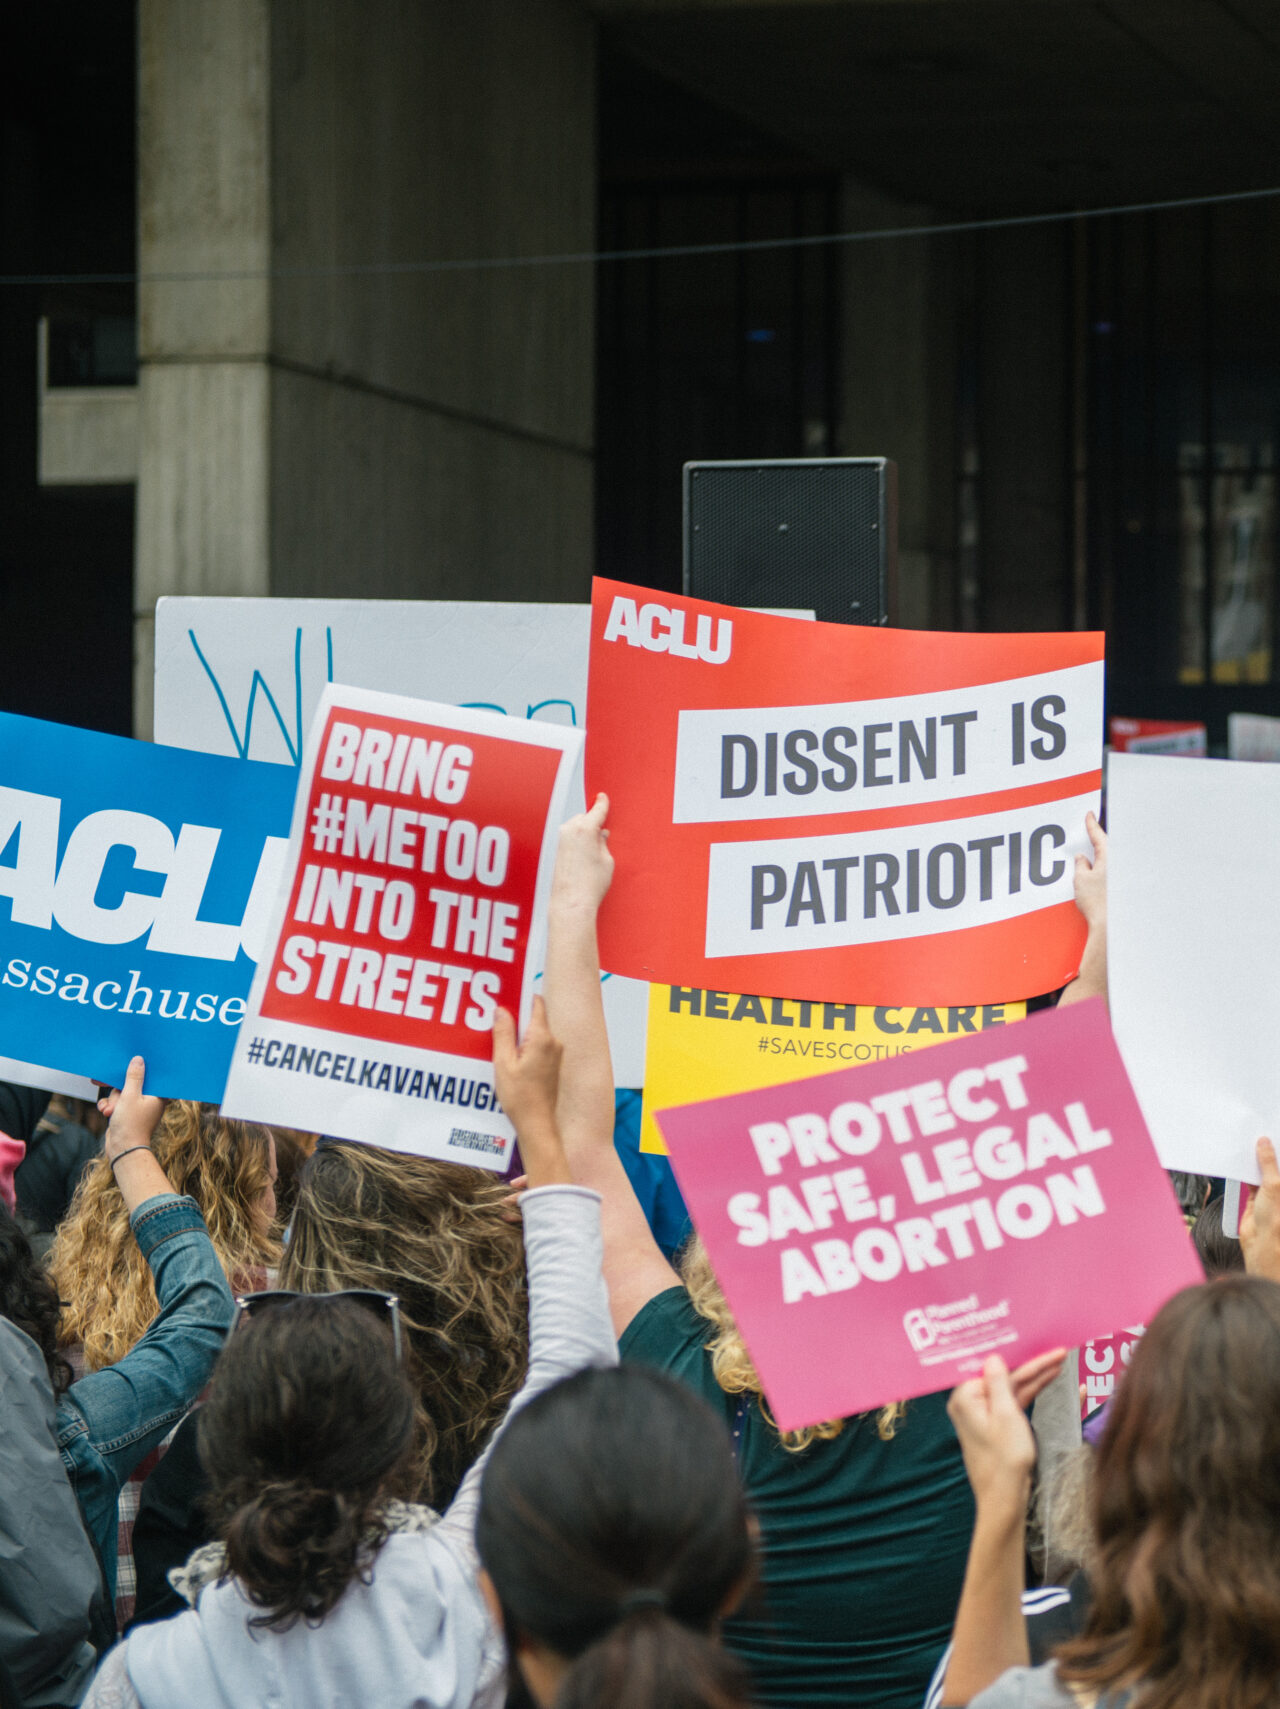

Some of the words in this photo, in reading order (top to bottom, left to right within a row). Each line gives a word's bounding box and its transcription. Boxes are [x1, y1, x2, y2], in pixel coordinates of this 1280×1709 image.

[603, 595, 733, 664] ACLU
[320, 722, 474, 804] BRING
[720, 710, 978, 799] DISSENT
[1011, 694, 1068, 766] IS
[310, 793, 510, 887] #METOO
[751, 824, 1067, 930] PATRIOTIC
[294, 864, 416, 942] INTO
[428, 886, 520, 963] THE
[2, 957, 248, 1026] ssachuse
[274, 935, 501, 1032] STREETS
[669, 985, 857, 1032] HEALTH
[873, 1002, 1007, 1034] CARE
[748, 1055, 1030, 1176] PROTECT
[727, 1167, 897, 1248] SAFE,
[900, 1102, 1113, 1205] LEGAL
[780, 1165, 1106, 1304] ABORTION
[925, 1293, 980, 1319] Planned
[931, 1300, 1011, 1334] Parenthood
